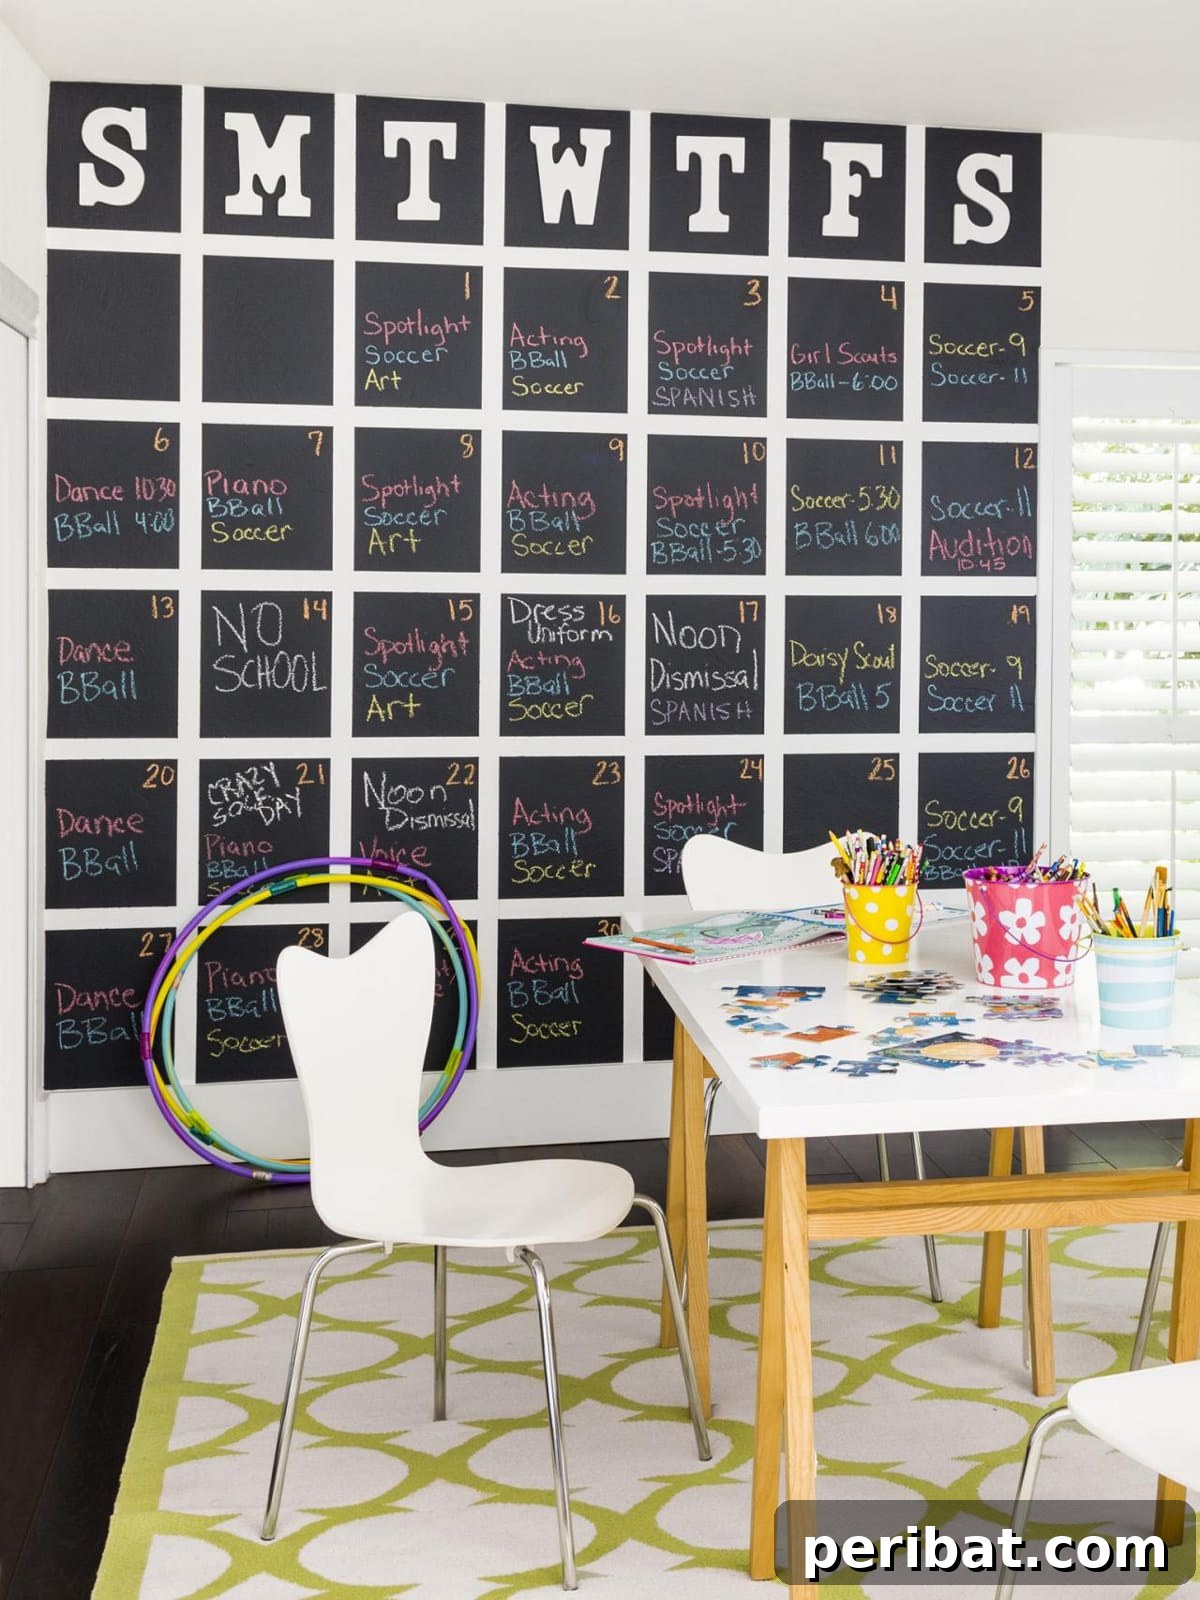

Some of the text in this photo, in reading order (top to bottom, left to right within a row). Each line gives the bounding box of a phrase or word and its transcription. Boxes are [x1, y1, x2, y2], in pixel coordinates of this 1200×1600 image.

[79, 107, 1013, 245] S M T W T F S
[464, 272, 471, 300] 1
[604, 275, 622, 300] 2
[744, 279, 762, 306] 3
[881, 284, 898, 310] 4
[1018, 290, 1034, 311] 5
[363, 308, 471, 346] Spotlight
[509, 322, 588, 358] Acting
[365, 345, 448, 365] Soccer
[509, 350, 567, 370] BBall
[654, 330, 753, 368] Spotlight
[791, 342, 897, 365] Girl Scouts
[364, 367, 402, 391] Art
[658, 362, 734, 381] Soccer
[512, 375, 584, 396] Soccer
[652, 385, 757, 408] SPANISH
[154, 426, 170, 451] 6
[308, 431, 323, 456] 7
[460, 433, 474, 459] 8
[609, 438, 624, 461] 9
[744, 441, 766, 465] 10
[880, 443, 897, 466] 11
[1014, 447, 1036, 470] 12
[54, 473, 123, 503] Dance
[203, 469, 288, 496] Piano
[361, 473, 461, 509] Spotlight
[206, 497, 282, 518] BBall
[507, 479, 597, 521] Acting
[652, 480, 758, 526] Spotlight
[54, 510, 120, 542] BBall
[364, 506, 447, 527] Soccer
[656, 517, 746, 538] Soccer
[211, 521, 294, 544] Soccer
[368, 527, 422, 556] Art
[511, 533, 594, 557] Soccer
[929, 527, 1033, 561] Audition
[152, 595, 175, 619] 13
[303, 597, 327, 620] 14
[448, 599, 473, 622] 15
[507, 596, 585, 624] Dress
[599, 600, 621, 626] 16
[739, 600, 759, 623] 17
[877, 603, 897, 624] 18
[1011, 604, 1031, 624] 19
[212, 602, 283, 652] NO
[527, 619, 613, 645] Uniform
[652, 610, 741, 653] Noon
[56, 636, 135, 666] Dance
[364, 626, 469, 672] Spotlight
[790, 639, 895, 685] Daisy Scout
[213, 650, 327, 692] SCHOOL
[364, 663, 455, 689] Soccer
[507, 650, 586, 679] Acting
[650, 649, 758, 692] Dismissal
[57, 670, 137, 704] BBall
[507, 672, 570, 697] BBall
[797, 682, 892, 712] BBall 5
[928, 684, 998, 712] Soccer
[366, 692, 421, 722] Art
[508, 694, 594, 721] Soccer
[650, 698, 752, 725] SPANISH
[142, 763, 175, 788] 20
[296, 763, 325, 785] 21
[446, 762, 475, 785] 22
[592, 760, 621, 785] 23
[740, 758, 763, 782] 24
[868, 757, 896, 782] 25
[1006, 756, 1031, 780] 26
[208, 761, 280, 805] CRAZY
[363, 771, 447, 808] Noon
[258, 786, 302, 826] DAY
[378, 799, 476, 831] Dismissal
[512, 796, 592, 834] Acting
[653, 791, 747, 828] Spotlight
[56, 807, 144, 838] Dance
[204, 833, 273, 860] Piano
[509, 827, 578, 859] BBall
[58, 840, 139, 881] BBall
[512, 859, 597, 884] Soccer
[139, 932, 172, 957] 27
[298, 927, 324, 949] 28
[511, 947, 584, 980] Acting
[54, 982, 142, 1015] Dance
[207, 988, 277, 1021] BBall
[506, 979, 579, 1009] BBall
[510, 1012, 582, 1044] Soccer
